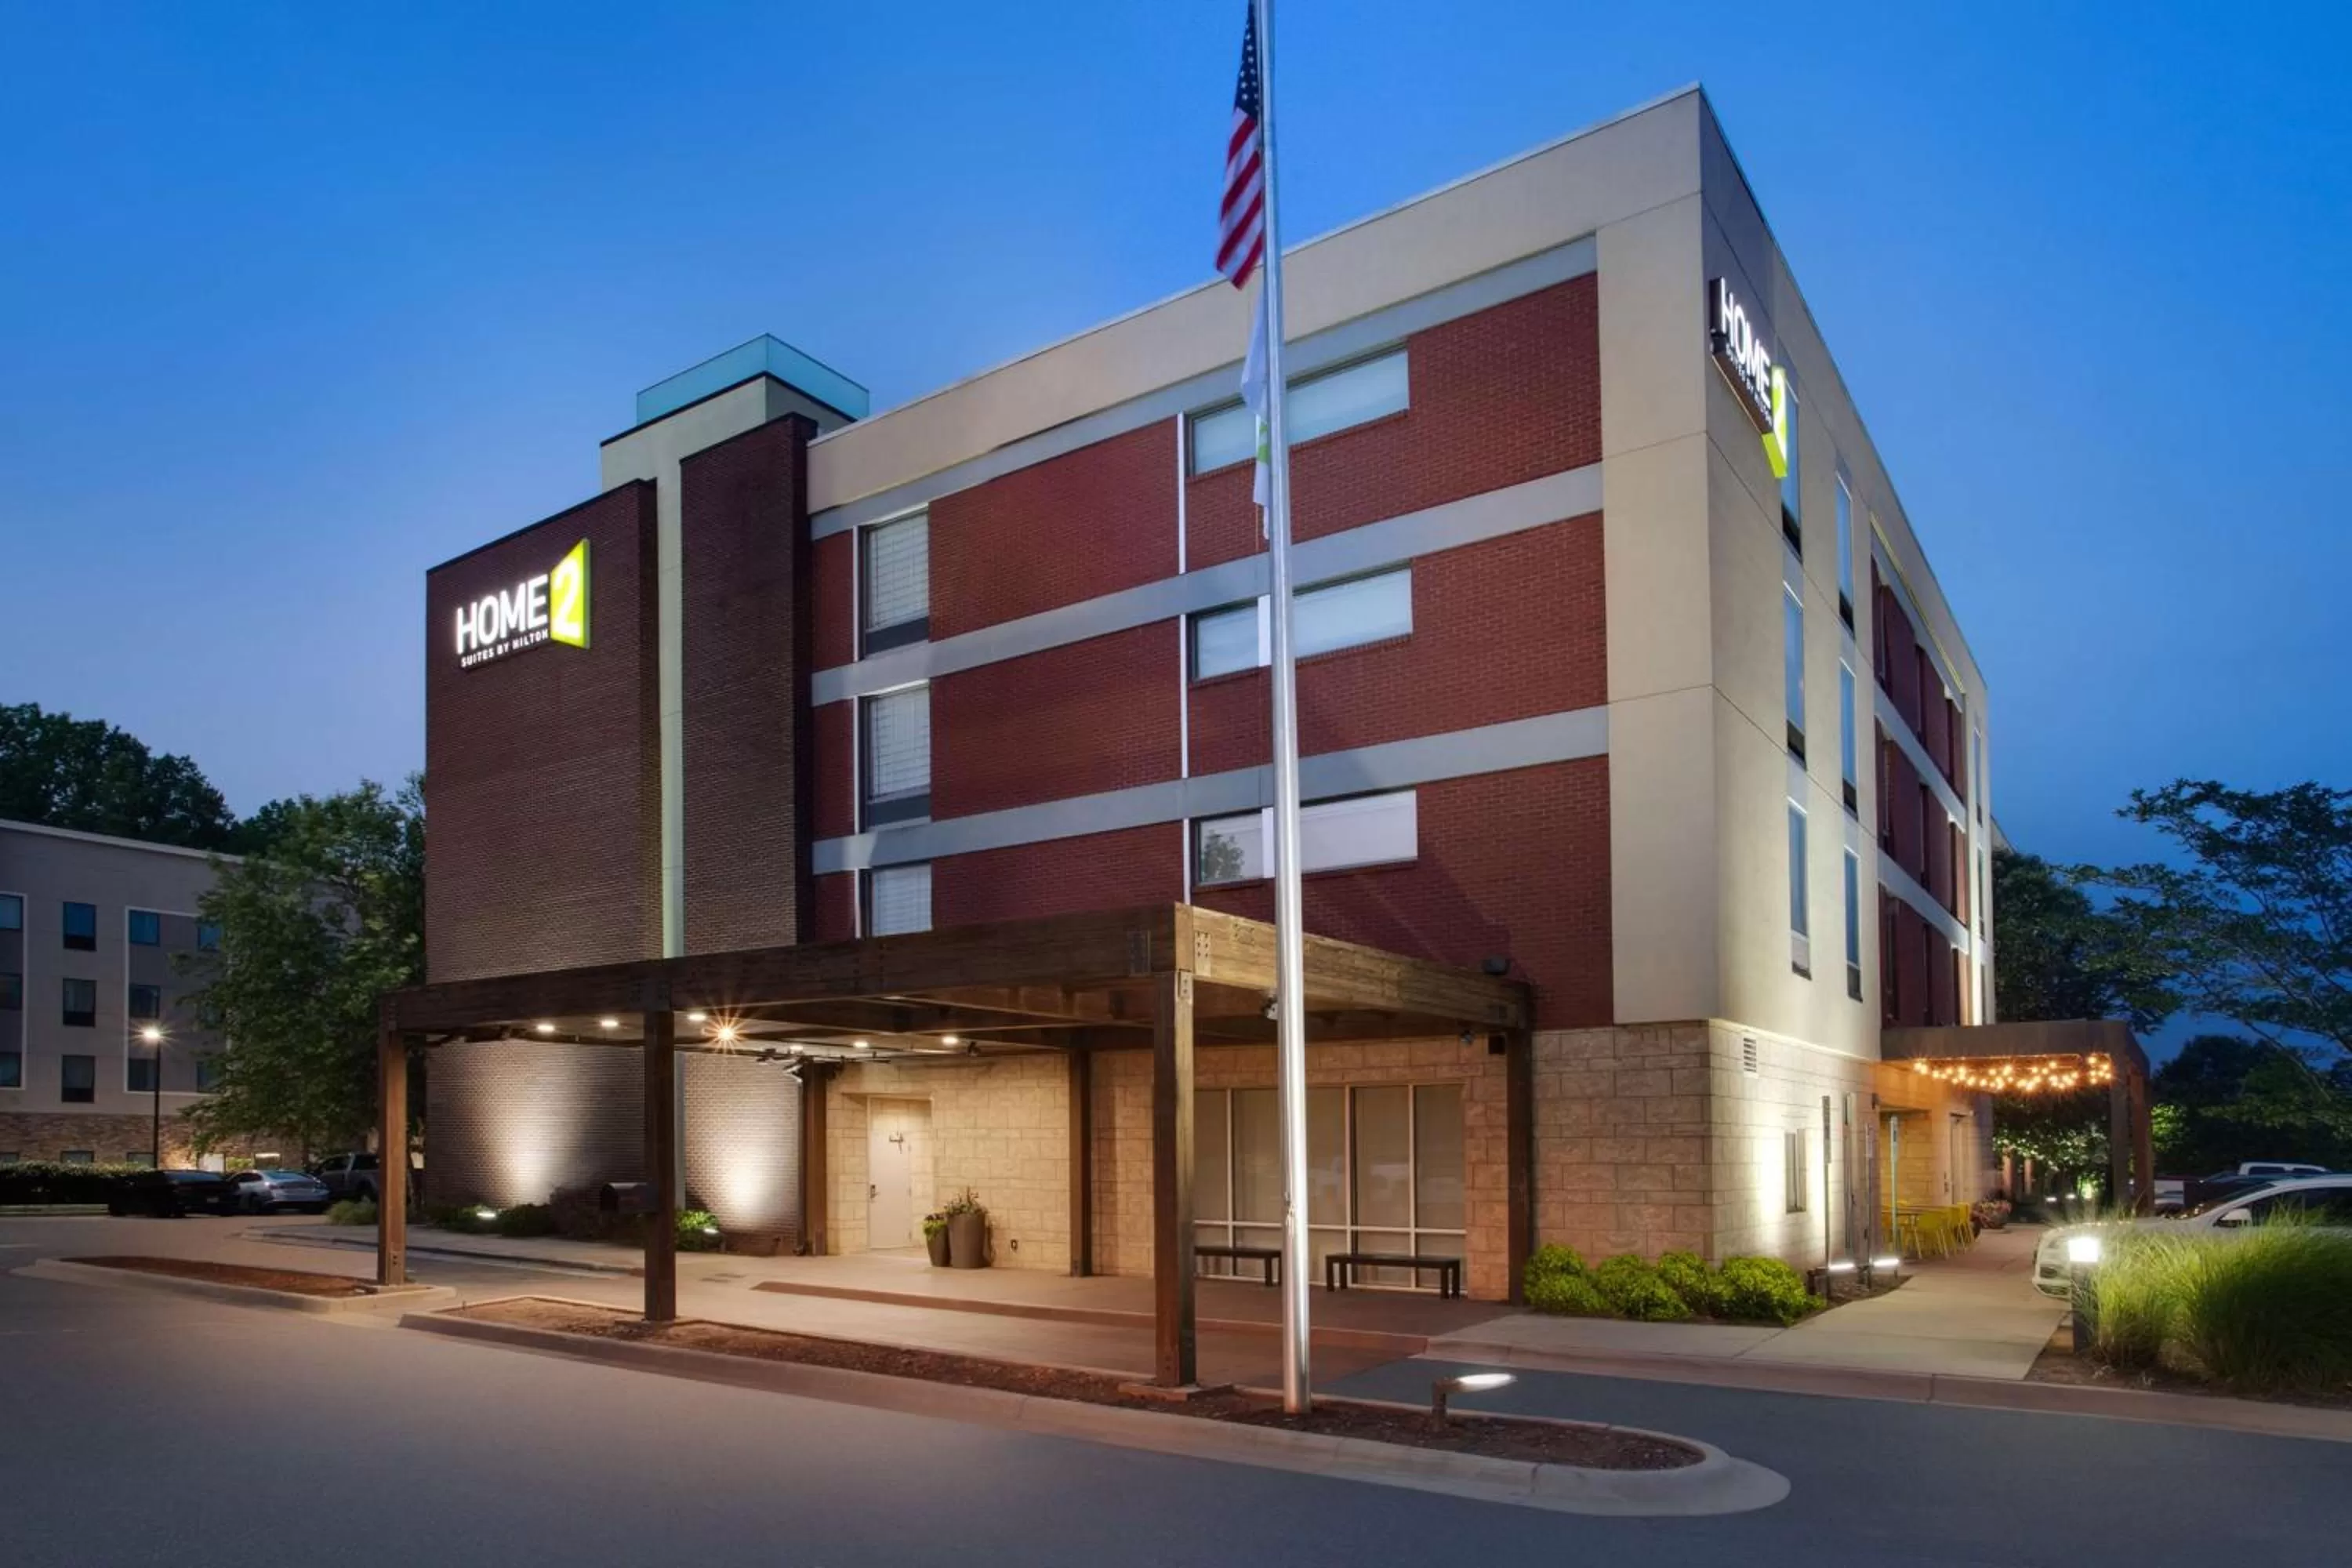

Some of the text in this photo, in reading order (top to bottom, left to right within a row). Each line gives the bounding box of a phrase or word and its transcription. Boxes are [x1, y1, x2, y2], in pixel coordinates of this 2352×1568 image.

[1721, 277, 1772, 409] HOME
[456, 573, 548, 655] HOME
[461, 627, 548, 668] SUITES BY HILTON
